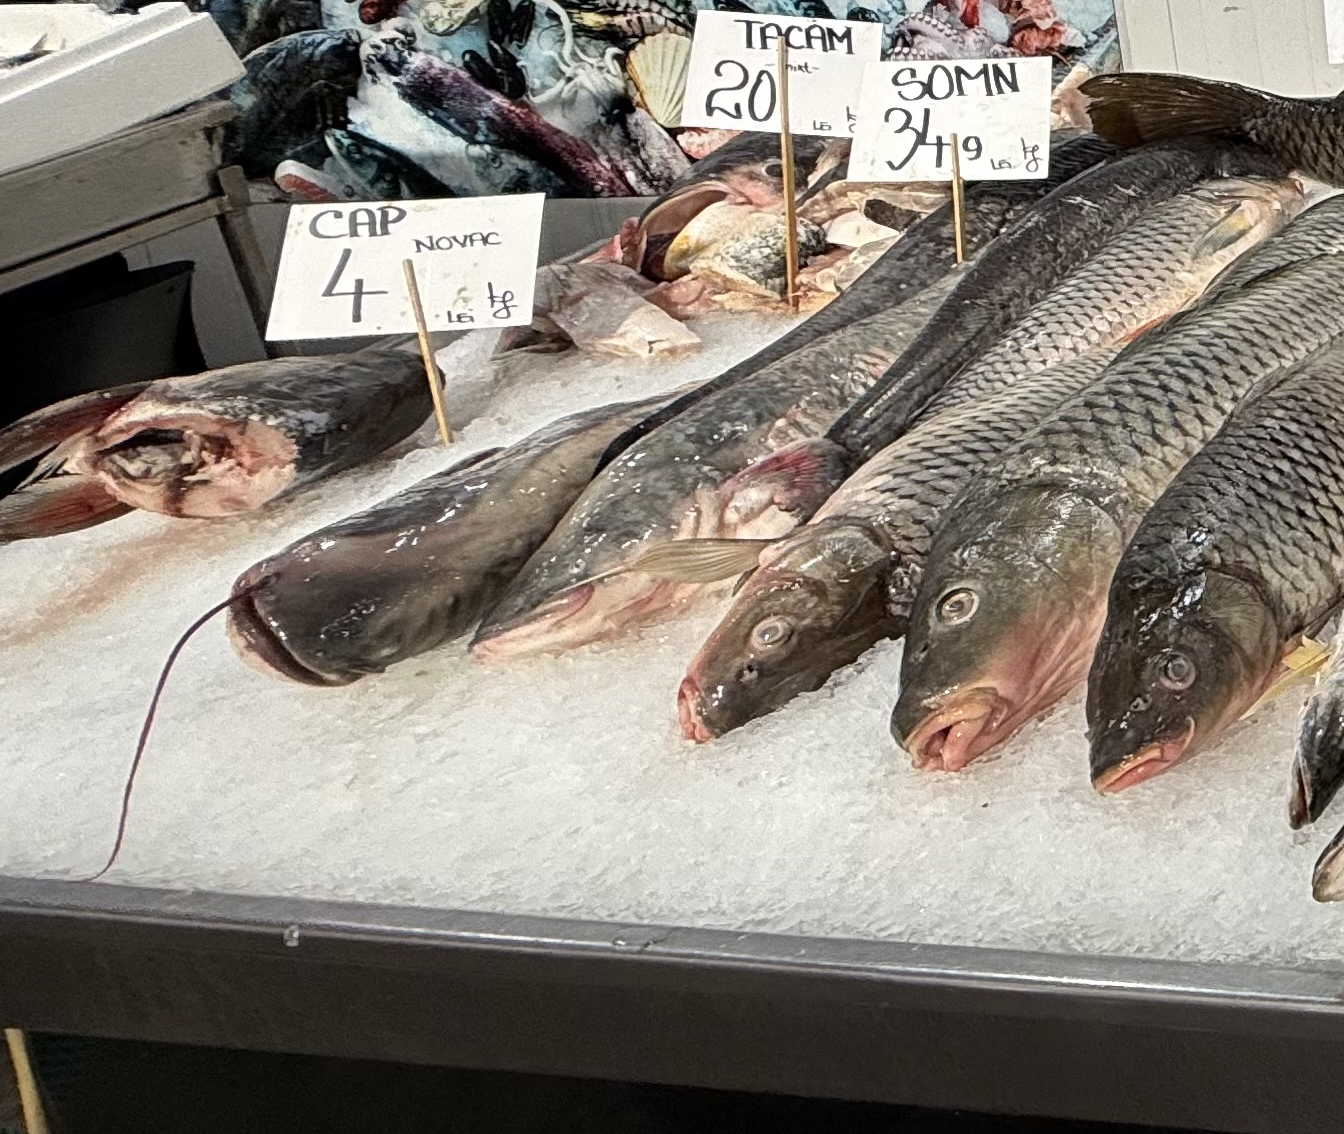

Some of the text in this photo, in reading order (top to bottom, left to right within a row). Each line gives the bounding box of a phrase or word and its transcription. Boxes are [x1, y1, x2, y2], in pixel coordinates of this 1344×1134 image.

[704, 59, 777, 123] 20
[890, 62, 1021, 102] SOMN
[308, 205, 408, 239] CAP
[412, 231, 503, 254] NOVAC
[320, 247, 389, 324] 4
